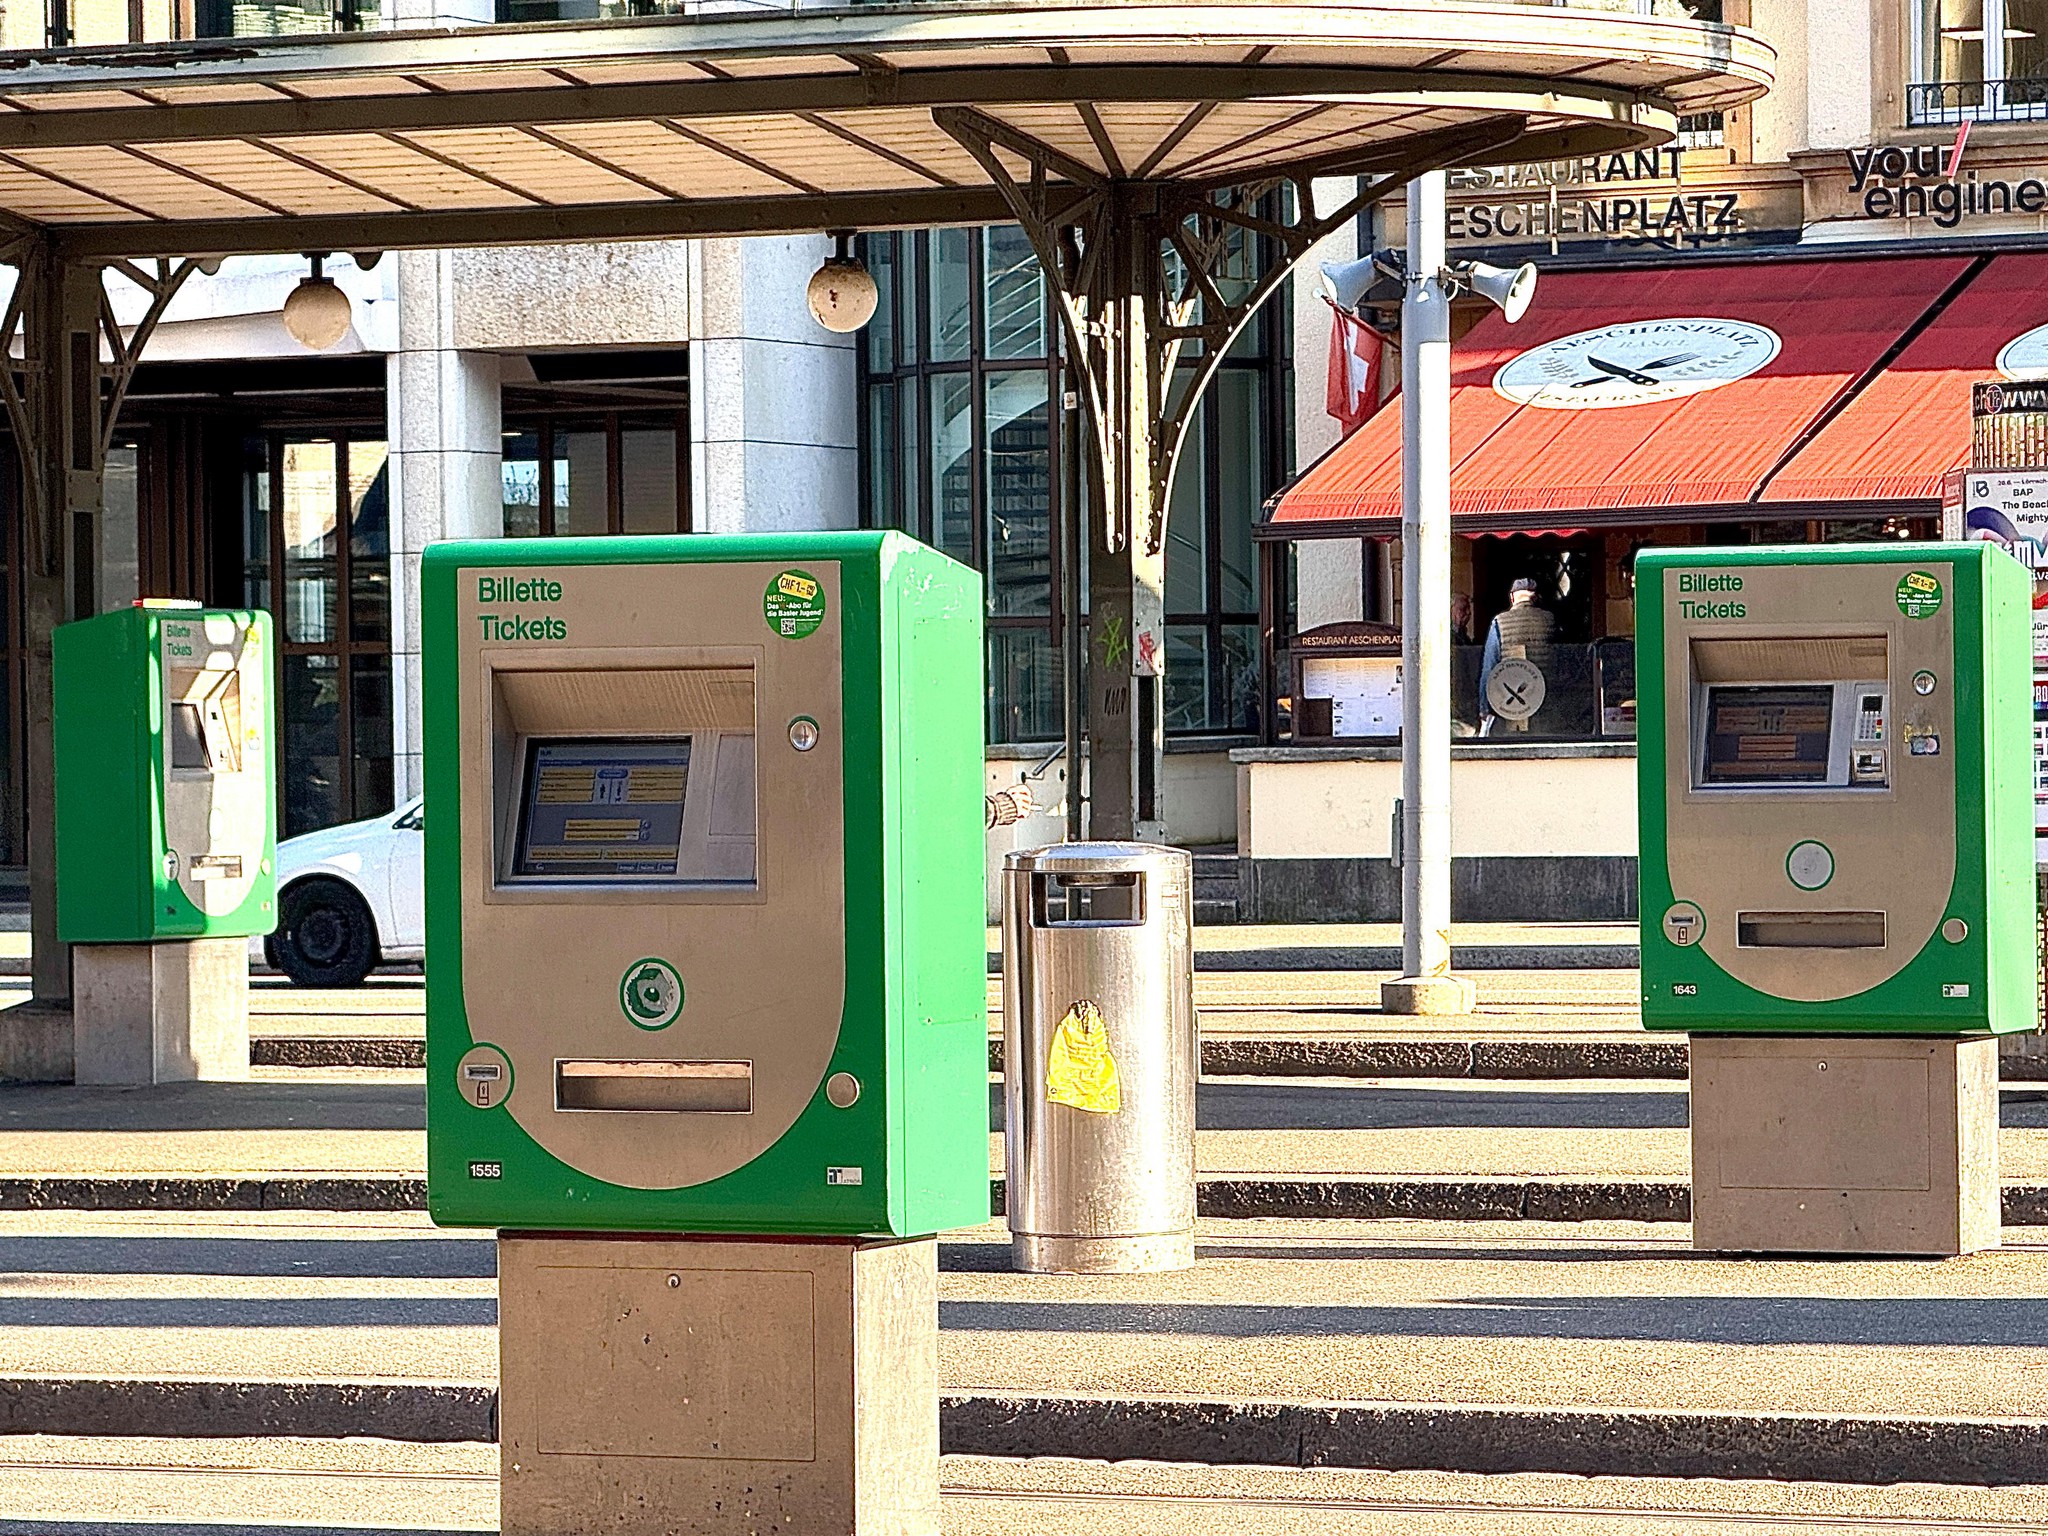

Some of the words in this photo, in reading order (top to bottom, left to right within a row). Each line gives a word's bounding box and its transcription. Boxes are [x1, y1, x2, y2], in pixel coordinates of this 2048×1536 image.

[1446, 194, 1739, 239] ESCHENPLATZ
[2013, 488, 2033, 497] BAP
[2002, 501, 2019, 509] The
[2016, 514, 2048, 523] Mighty
[479, 576, 562, 602] Billette
[780, 577, 796, 590] CHF
[1679, 574, 1743, 592] Billette
[1678, 600, 1746, 619] Tickets
[478, 614, 567, 640] Tickets
[1302, 636, 1347, 646] RESTAURANT
[1673, 985, 1697, 995] 1643
[470, 1164, 501, 1177] 1555
